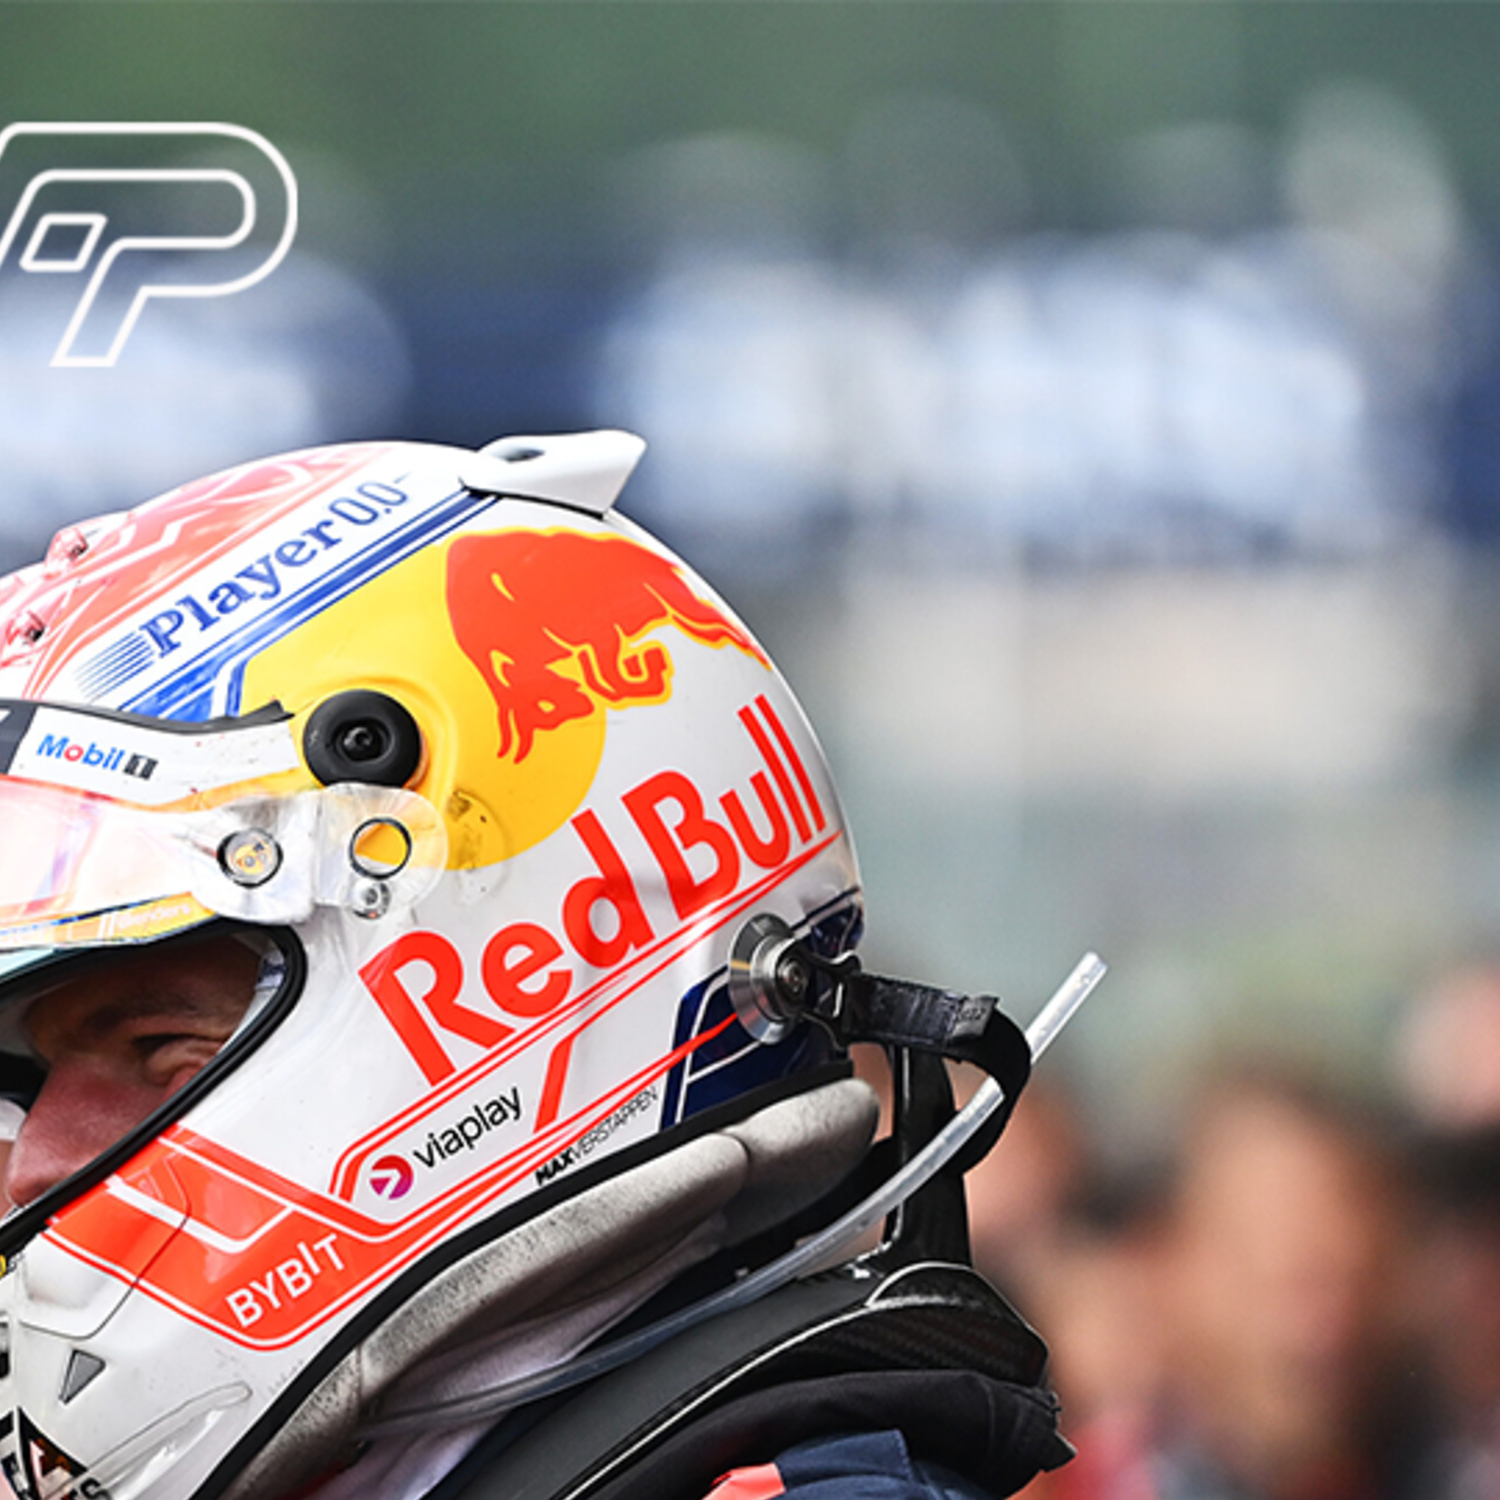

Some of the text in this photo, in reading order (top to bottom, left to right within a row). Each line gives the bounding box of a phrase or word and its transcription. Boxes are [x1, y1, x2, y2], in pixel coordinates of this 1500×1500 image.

[139, 520, 342, 658] Player
[37, 733, 125, 771] Mobil
[358, 695, 825, 1087] Red Bull
[413, 1086, 523, 1169] viaplay
[227, 1234, 345, 1328] BYBIT
